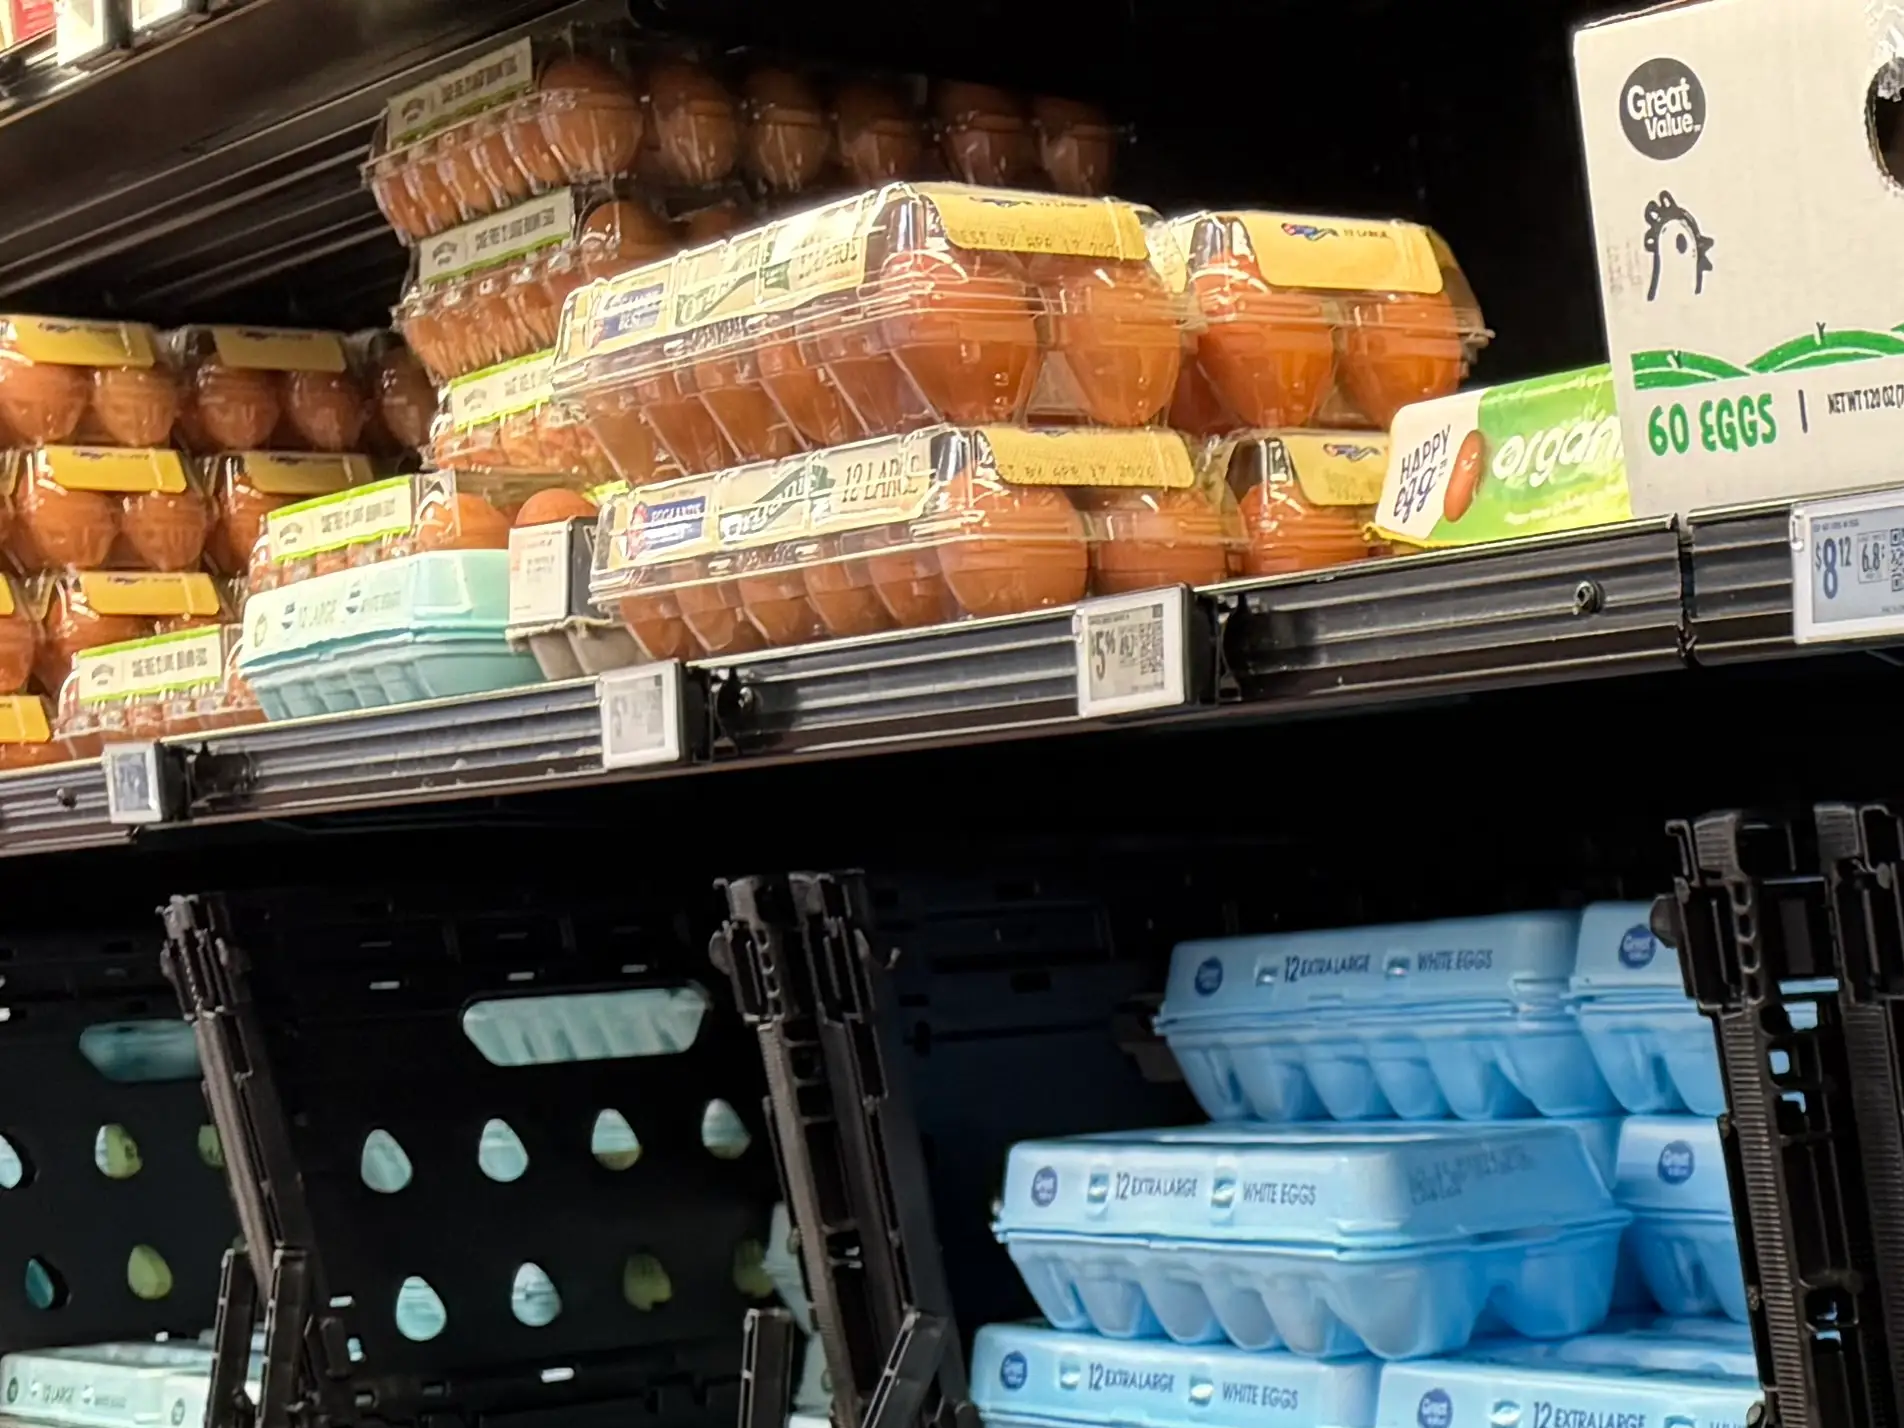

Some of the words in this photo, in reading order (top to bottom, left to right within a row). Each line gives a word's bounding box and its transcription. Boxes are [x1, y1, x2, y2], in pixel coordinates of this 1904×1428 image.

[1627, 77, 1692, 121] Great
[1648, 404, 1689, 456] 60
[1700, 393, 1777, 454] EGGS
[1400, 424, 1450, 484] HAPPY
[1393, 465, 1437, 524] egg
[1284, 954, 1300, 983] 12
[1417, 952, 1451, 972] WHITE
[1454, 949, 1493, 970] EGGS
[1088, 1363, 1103, 1391] 12
[1222, 1382, 1257, 1407] WHITE
[1261, 1386, 1299, 1411] EGGS
